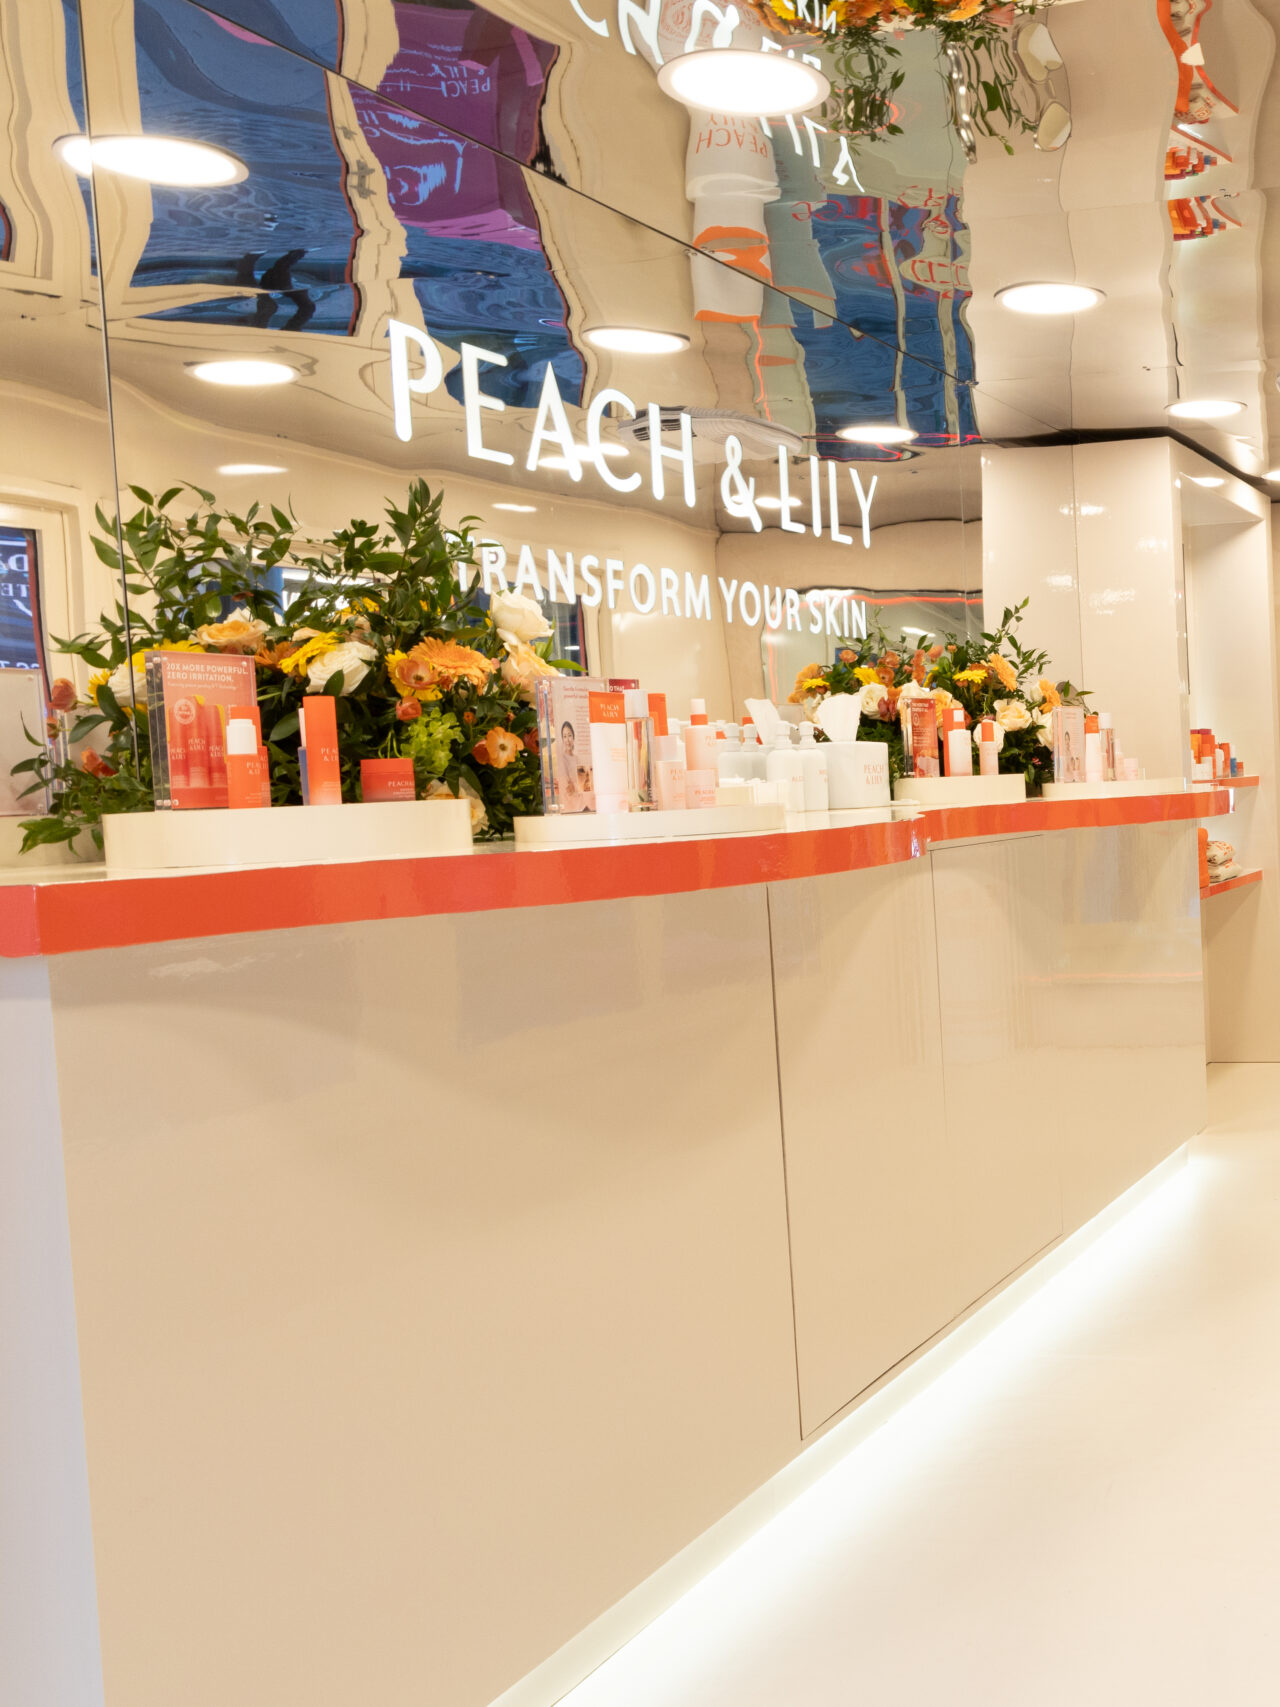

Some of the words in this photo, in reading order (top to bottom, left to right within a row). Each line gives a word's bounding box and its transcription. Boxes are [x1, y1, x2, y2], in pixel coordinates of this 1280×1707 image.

[388, 318, 697, 508] PEACH
[720, 434, 763, 533] &
[778, 444, 878, 549] LILY
[444, 533, 713, 622] TRANSFORM
[717, 576, 802, 632] YOUR
[809, 592, 868, 640] SKIN
[167, 671, 188, 680] ZERO
[189, 672, 234, 682] IRRITATION.
[182, 664, 205, 673] MORE
